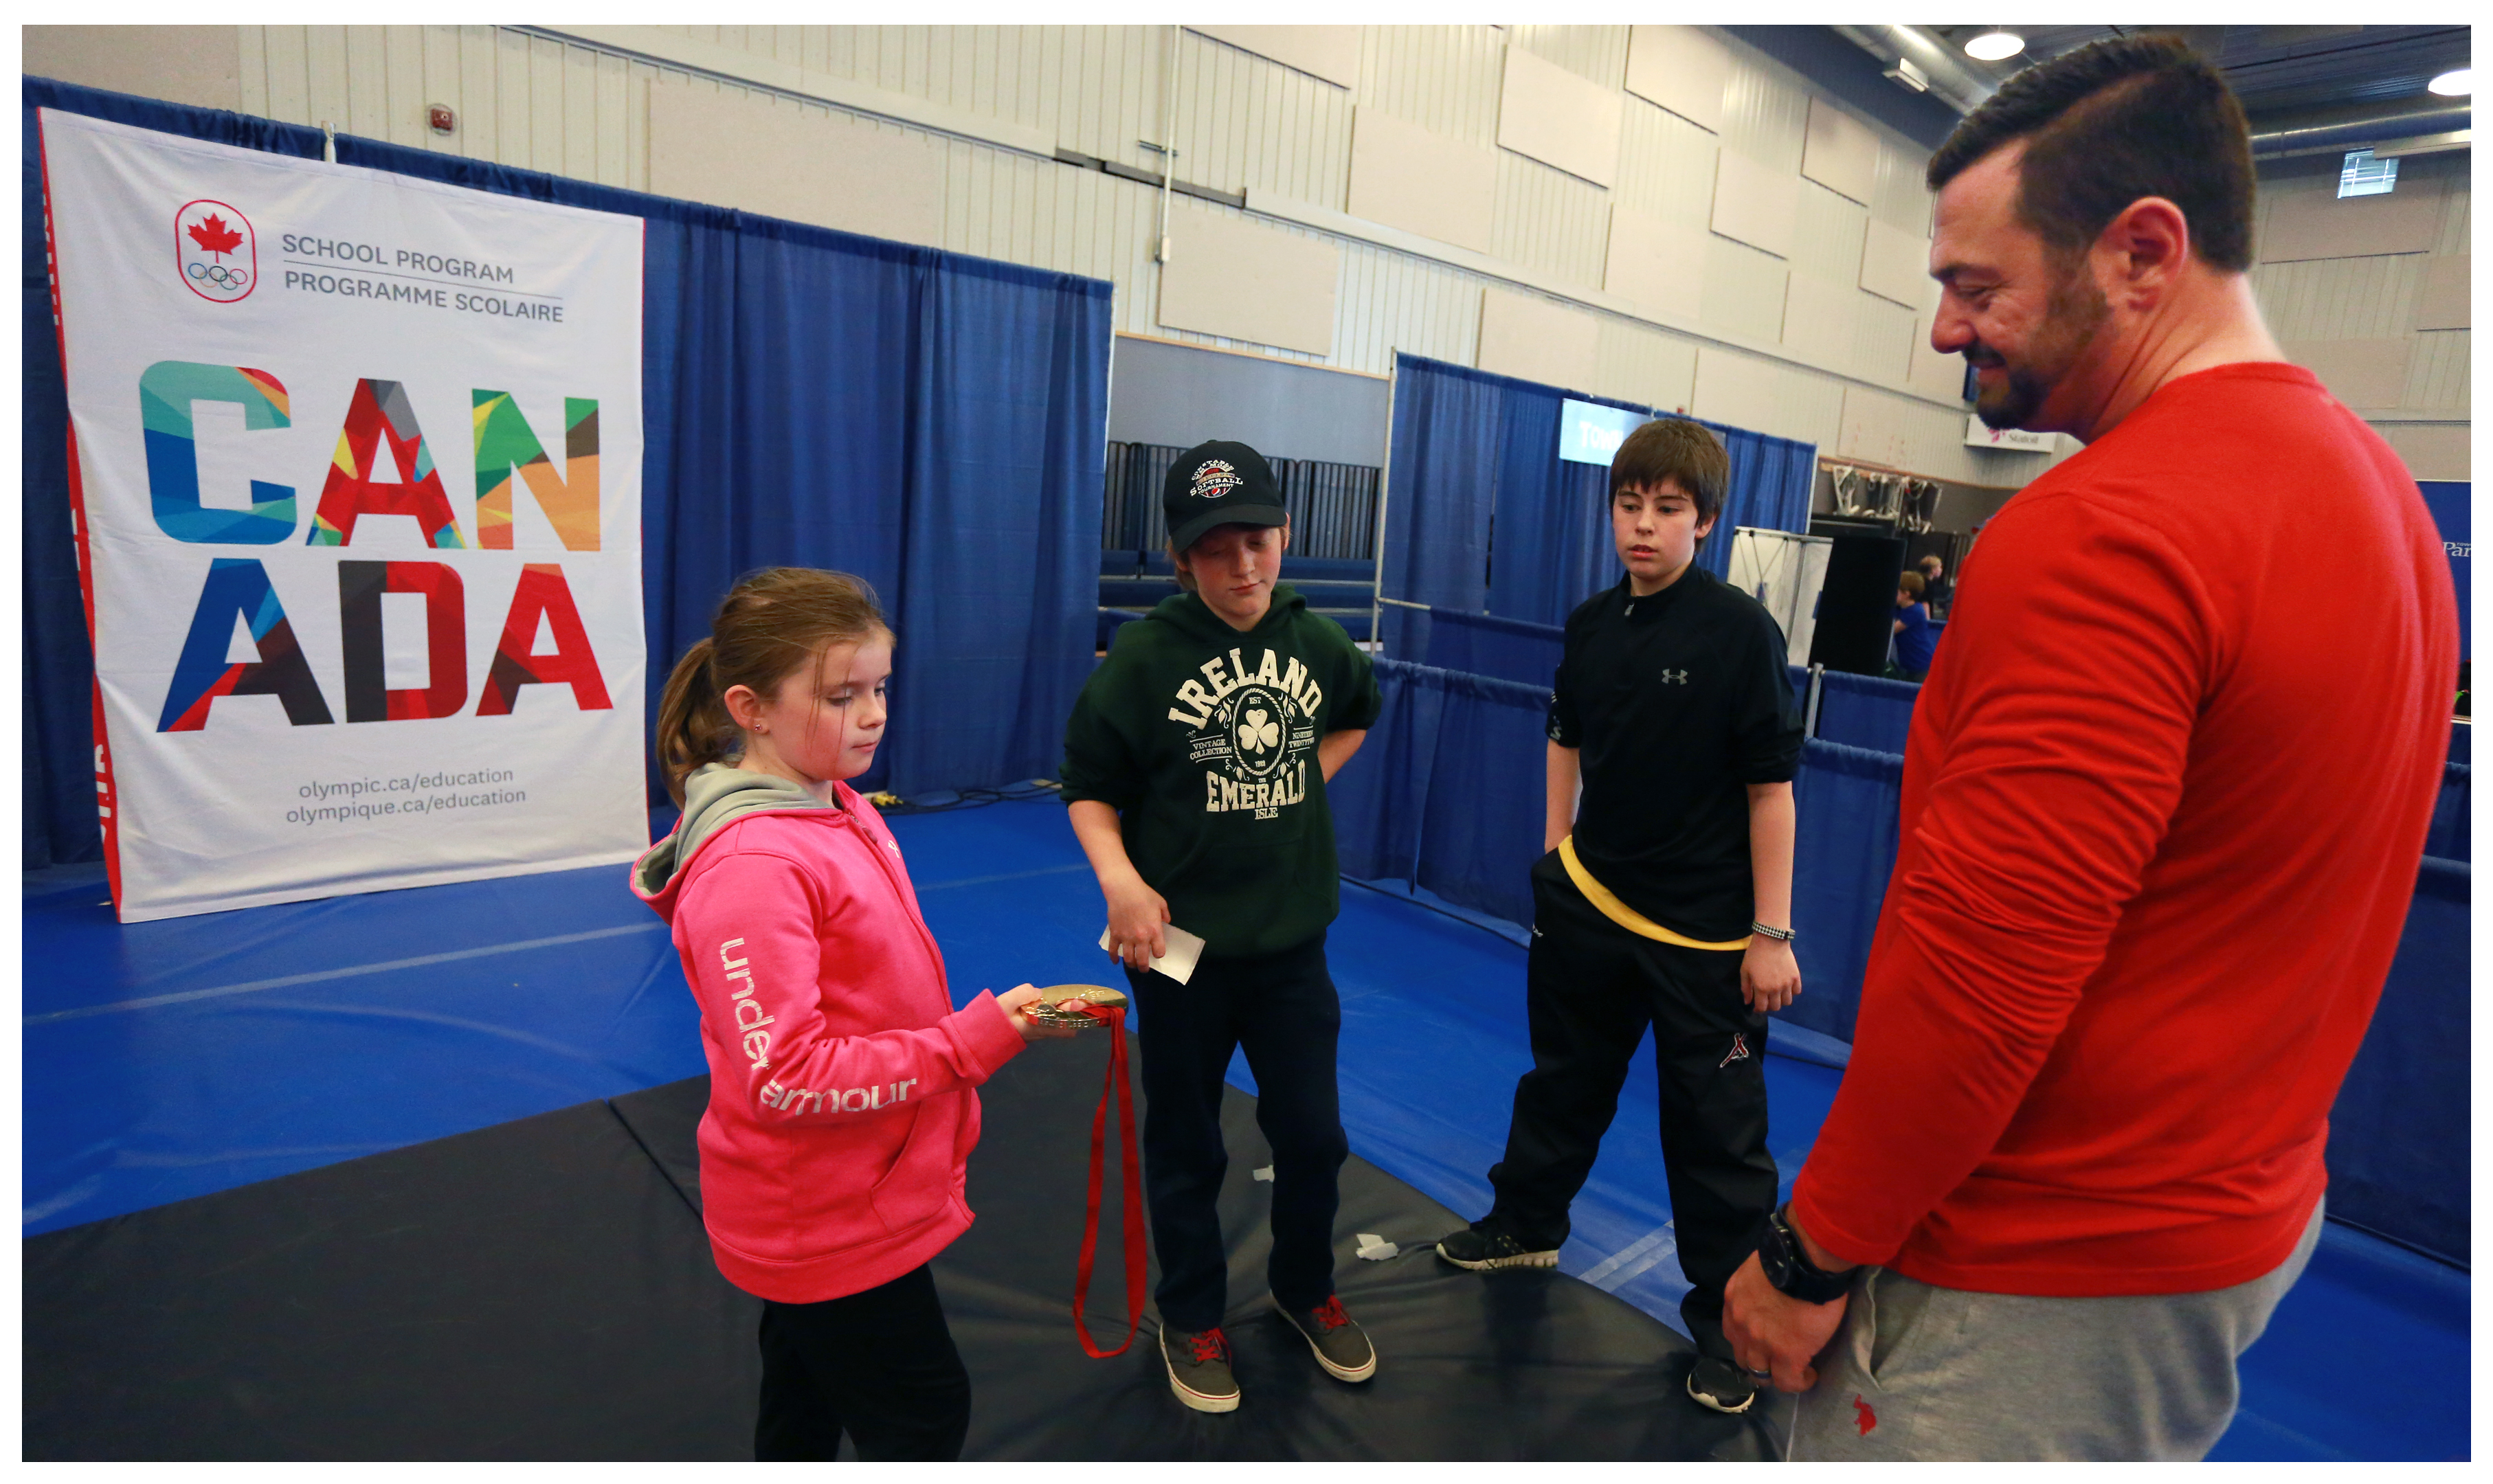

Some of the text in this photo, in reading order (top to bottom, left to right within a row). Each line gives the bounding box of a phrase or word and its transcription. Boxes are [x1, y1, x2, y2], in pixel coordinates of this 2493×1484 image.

[282, 234, 513, 284] SCHOOL PROGRAM
[285, 271, 563, 323] PROGRAMME SCOLAIRE
[139, 360, 600, 552] CAN
[1190, 477, 1243, 496] SOFTBALL
[1198, 484, 1234, 495] TOURNAMENT
[156, 558, 614, 733] ADA
[1167, 648, 1322, 730] IRELAND
[1189, 747, 1233, 760] COLLECTION
[1193, 739, 1226, 750] VINTAGE
[299, 768, 514, 802] olympic.ca/education
[1206, 759, 1305, 812] EMERALD
[286, 789, 526, 826] olympique.ca/education
[1255, 807, 1278, 820] ISLE
[719, 937, 776, 1071] under
[760, 1078, 917, 1116] armour
